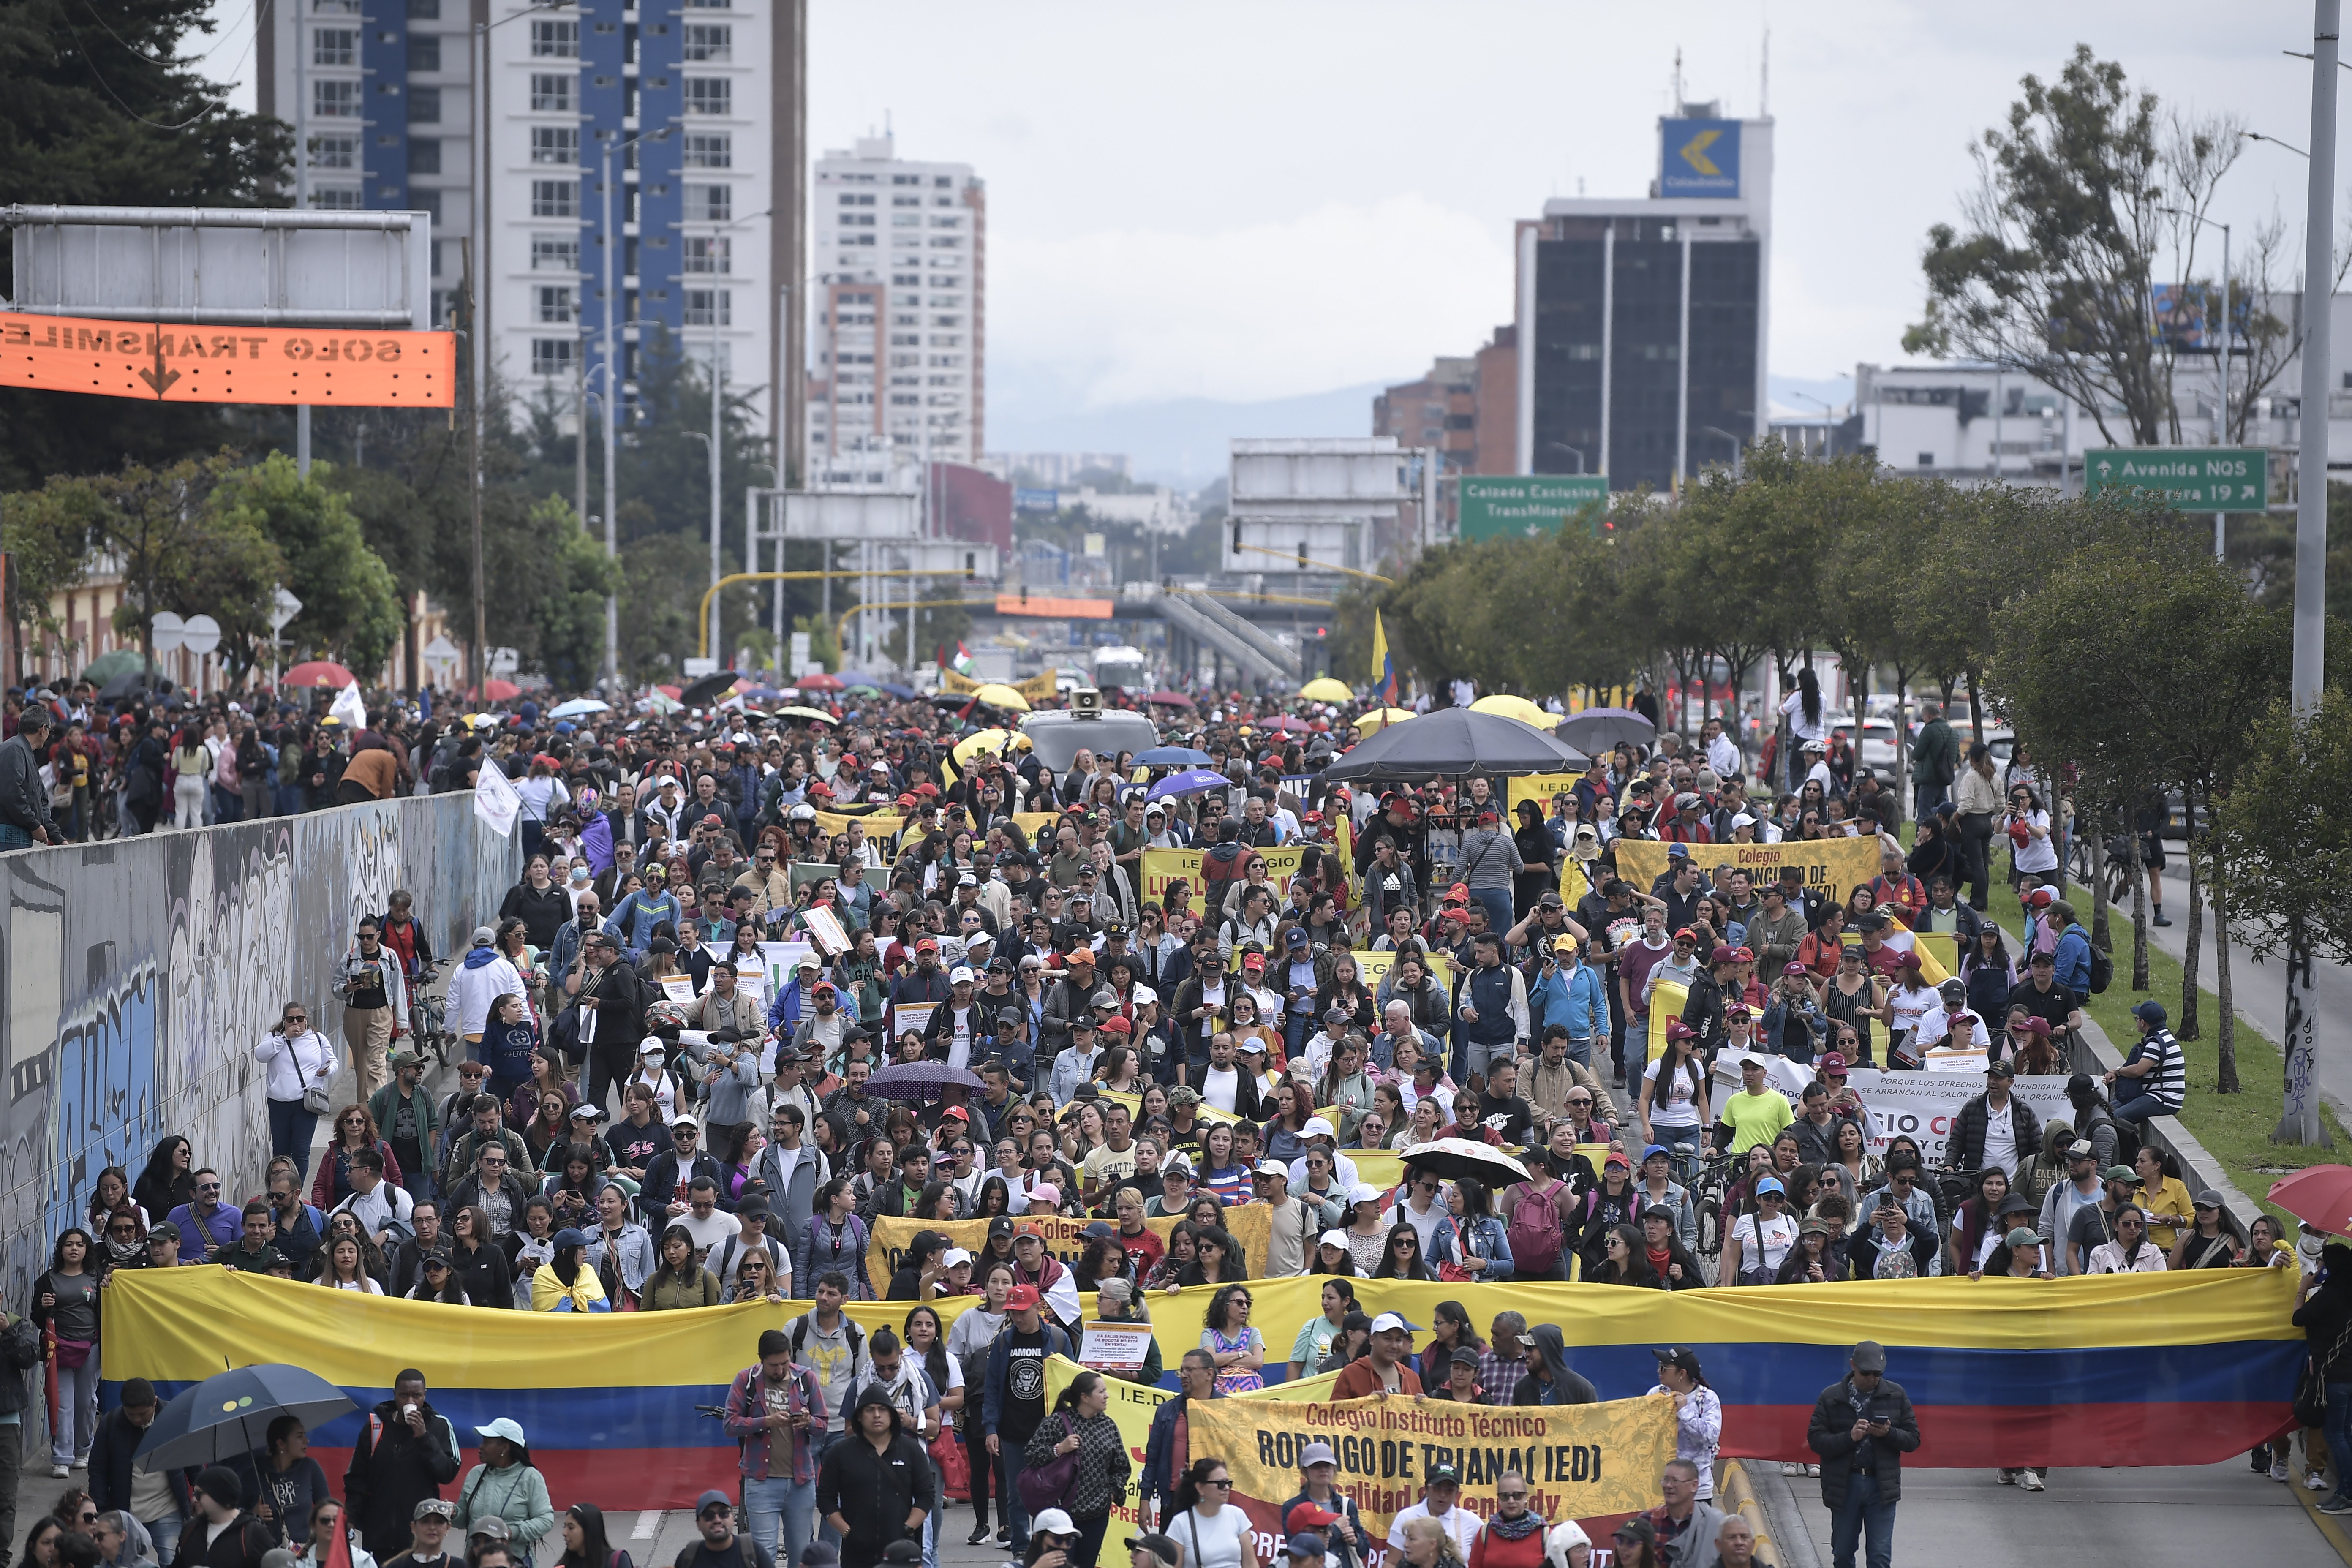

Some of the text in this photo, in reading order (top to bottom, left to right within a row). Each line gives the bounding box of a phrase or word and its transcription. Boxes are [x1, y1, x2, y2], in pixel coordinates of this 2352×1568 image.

[2122, 460, 2247, 477] Avenida NQS
[1467, 485, 1600, 499] Calzada Exclusiva
[2210, 485, 2232, 501] 19
[1738, 848, 1781, 866] Colegio
[1810, 865, 1825, 885] DE
[1701, 1015, 1712, 1039] GIRL
[1875, 1088, 1923, 1096] ARRANCAN
[1938, 1080, 1983, 1089] DERECHOS
[1306, 1402, 1546, 1439] Colegio Instituto Técnico
[1381, 1440, 1413, 1479] DE
